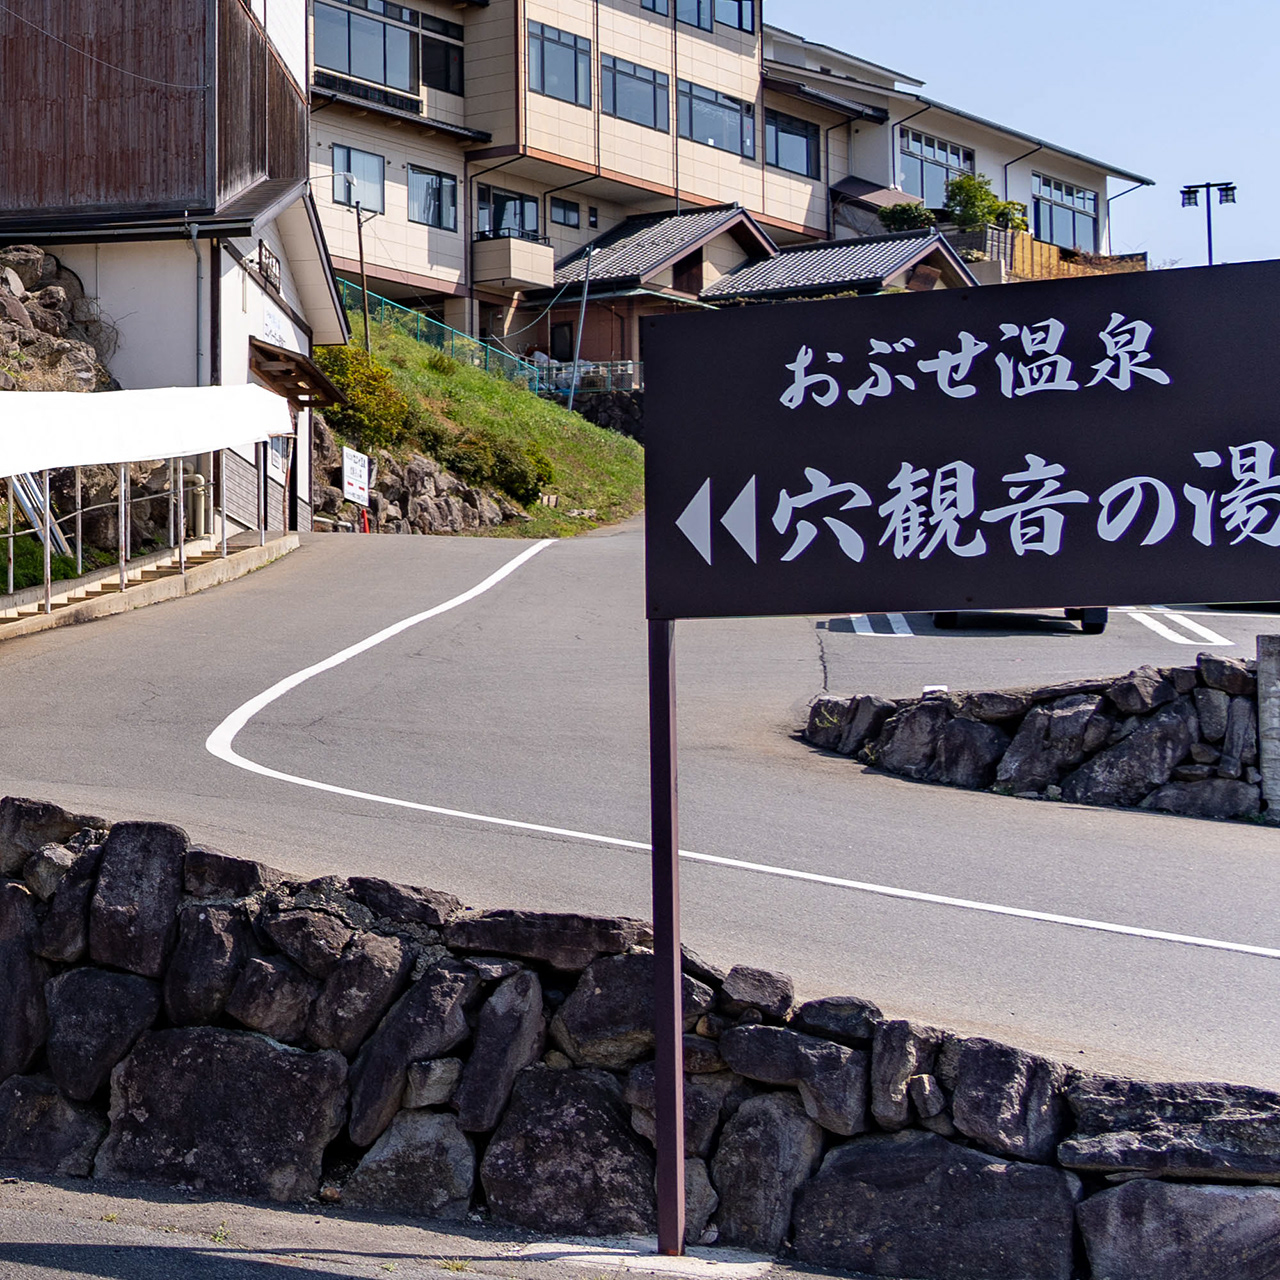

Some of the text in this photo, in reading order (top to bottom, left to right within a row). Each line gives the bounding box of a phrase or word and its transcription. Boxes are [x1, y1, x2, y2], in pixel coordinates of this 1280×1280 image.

[779, 312, 1171, 410] おぶせ温泉
[771, 440, 1280, 563] 穴観音の湯
